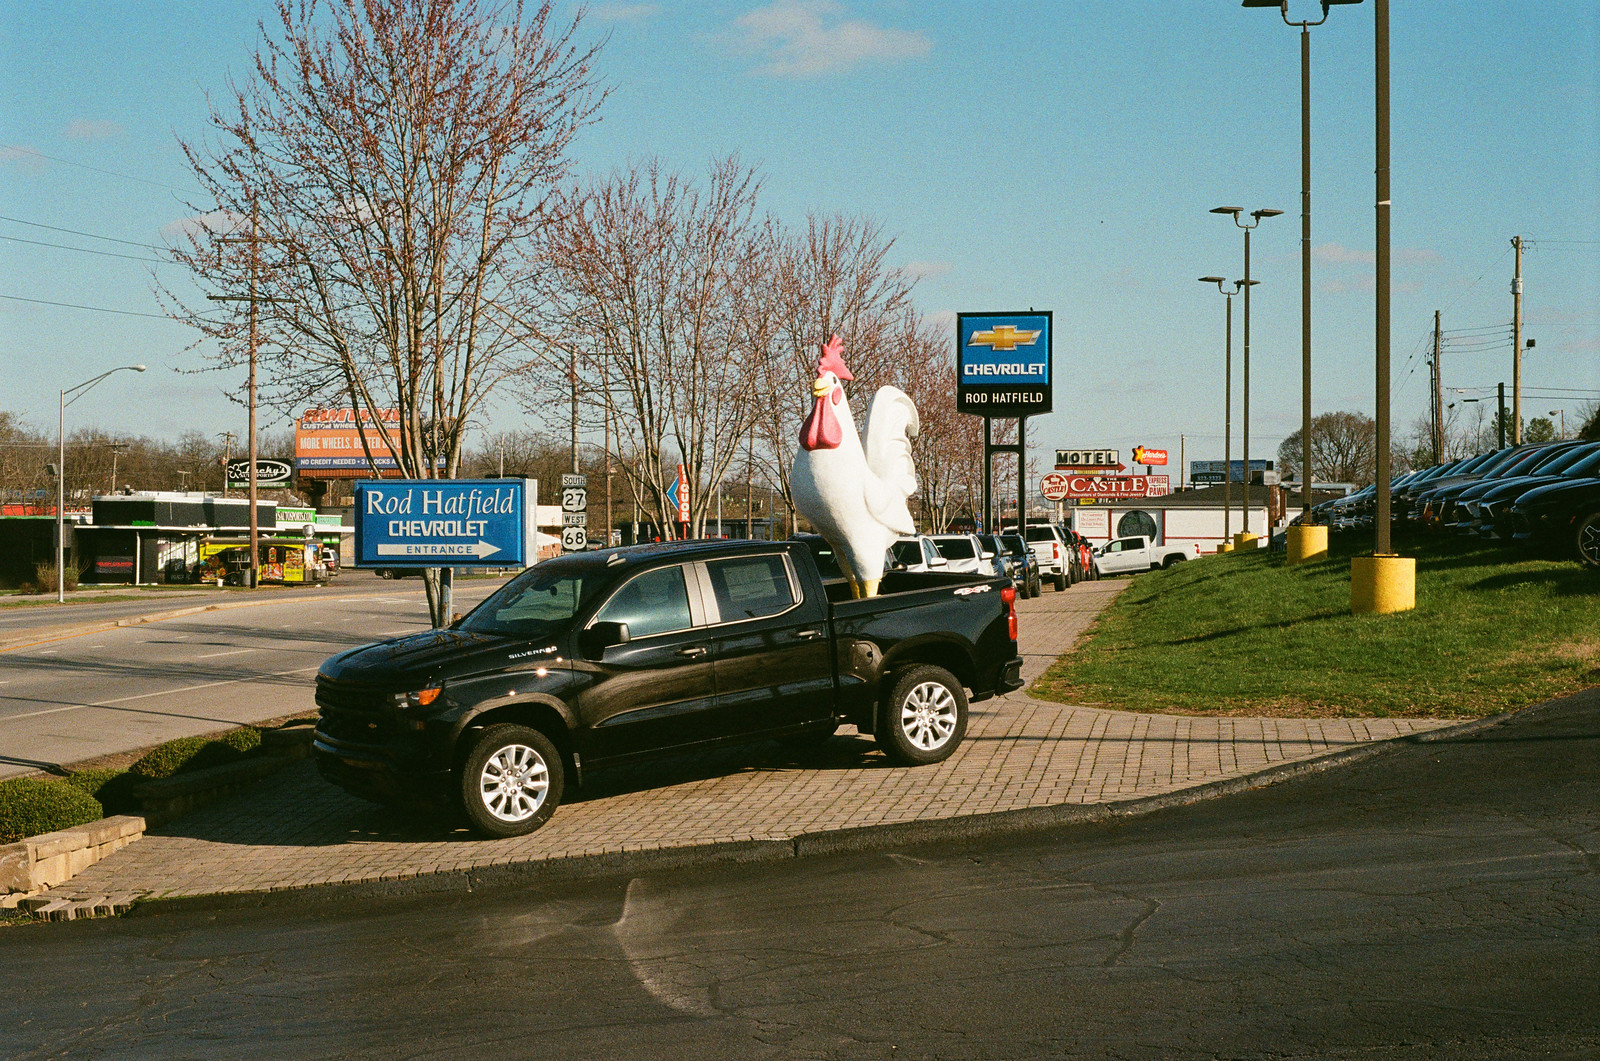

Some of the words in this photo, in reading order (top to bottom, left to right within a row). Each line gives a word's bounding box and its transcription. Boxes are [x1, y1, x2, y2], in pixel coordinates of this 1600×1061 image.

[964, 363, 1045, 376] CHEVROLET
[965, 392, 988, 403] ROD
[992, 392, 1043, 403] HATFIELD
[300, 437, 320, 449] MORE
[354, 437, 381, 449] BETER
[1056, 452, 1116, 464] MOTEL
[241, 466, 287, 477] Lcky's
[563, 476, 585, 485] SOUTH
[1070, 477, 1145, 492] CASTLE
[1148, 475, 1167, 484] EXPRESS
[680, 465, 690, 521] LIQUOR
[1148, 486, 1167, 496] PAWN
[366, 489, 413, 515] Rod
[422, 488, 514, 520] Hatfield
[565, 493, 584, 506] 27
[564, 515, 584, 523] WEST
[388, 520, 488, 537] CHEVROLET
[566, 532, 584, 544] 68
[406, 545, 472, 554] ENTRANCE
